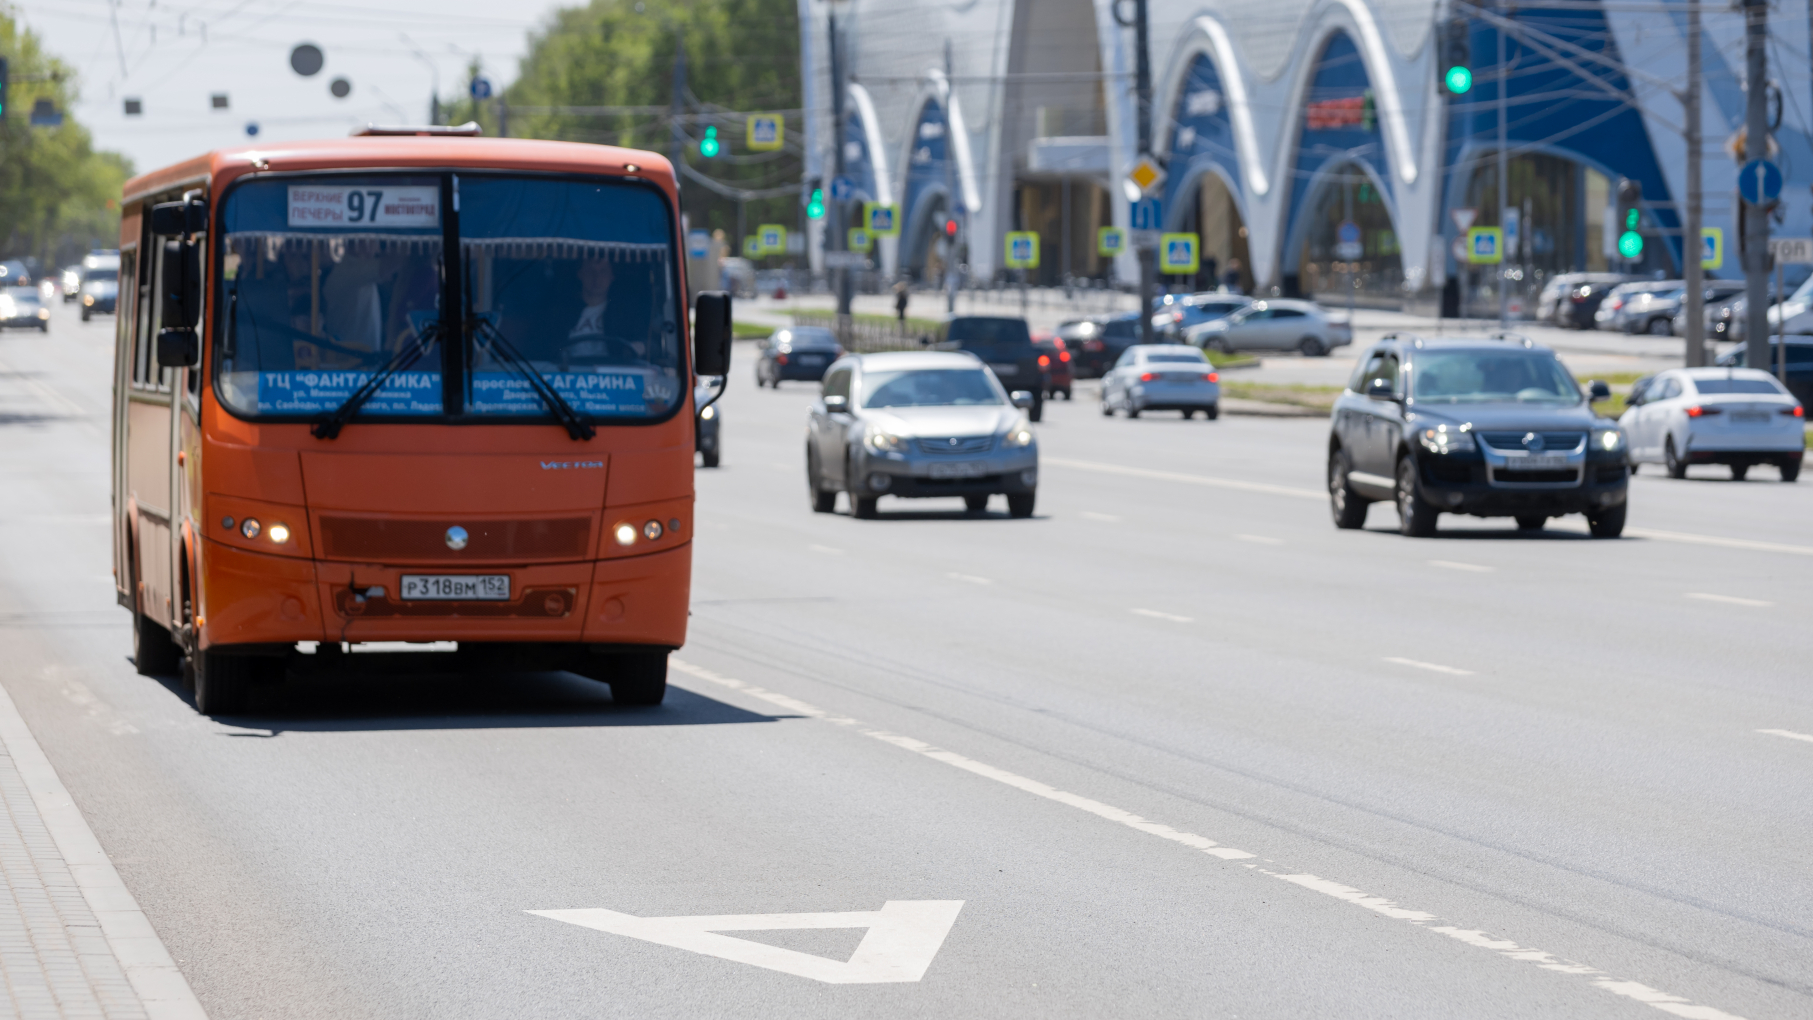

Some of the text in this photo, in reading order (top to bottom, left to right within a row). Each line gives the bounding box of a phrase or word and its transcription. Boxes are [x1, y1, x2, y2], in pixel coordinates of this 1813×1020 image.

[292, 190, 343, 204] ВЕРХНИЕ
[292, 206, 343, 221] ПЕЧЕРЫ
[347, 190, 384, 222] 97
[265, 373, 290, 390] ТЦ
[473, 374, 637, 391] проспек ГАГАРИНА
[407, 577, 505, 596] Р318ВМ 152
